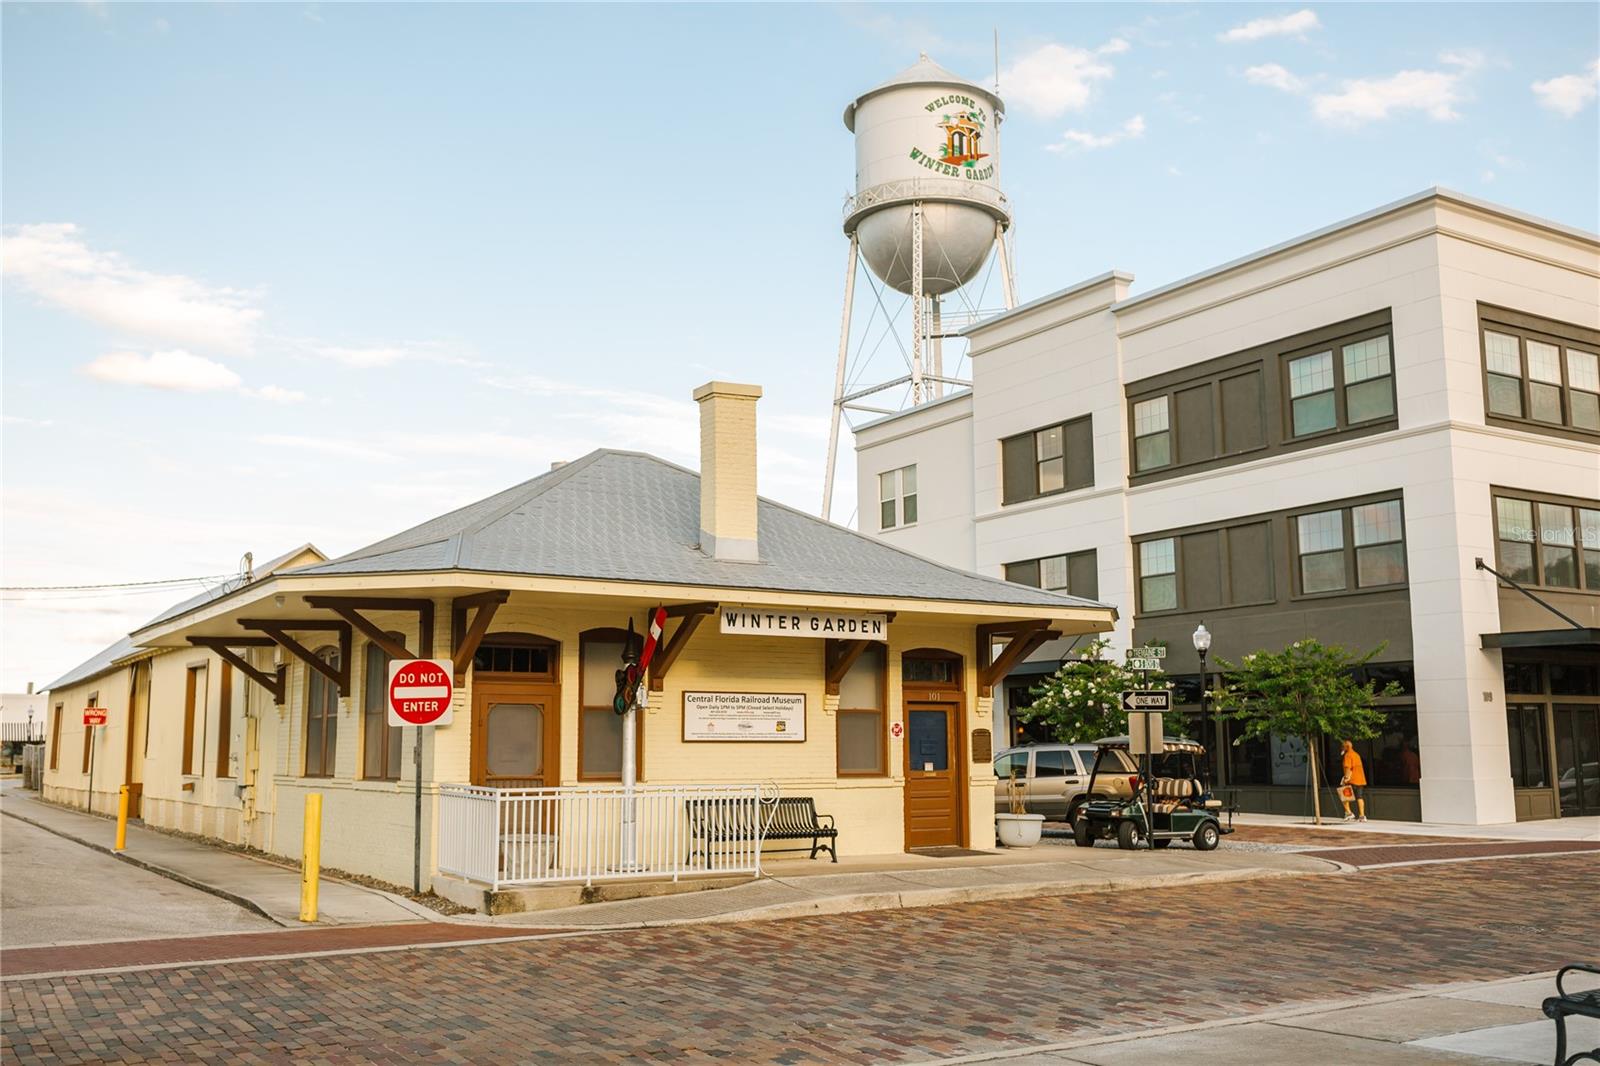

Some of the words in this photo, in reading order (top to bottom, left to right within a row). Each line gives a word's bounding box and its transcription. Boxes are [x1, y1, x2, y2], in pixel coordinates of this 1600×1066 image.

[925, 95, 975, 113] WELCOME
[909, 146, 960, 178] WINTER
[965, 162, 994, 181] GARDEN
[725, 612, 800, 631] WINTER
[810, 617, 882, 634] GARDEN
[399, 673, 415, 684] DO
[420, 672, 444, 683] NOT
[687, 694, 714, 703] Central
[715, 695, 740, 703] Florida
[741, 695, 771, 704] Railroad
[772, 696, 802, 704] Museum
[928, 692, 940, 701] 101
[1135, 696, 1149, 705] ONE
[1150, 696, 1165, 705] WAY
[403, 701, 439, 712] ENTER
